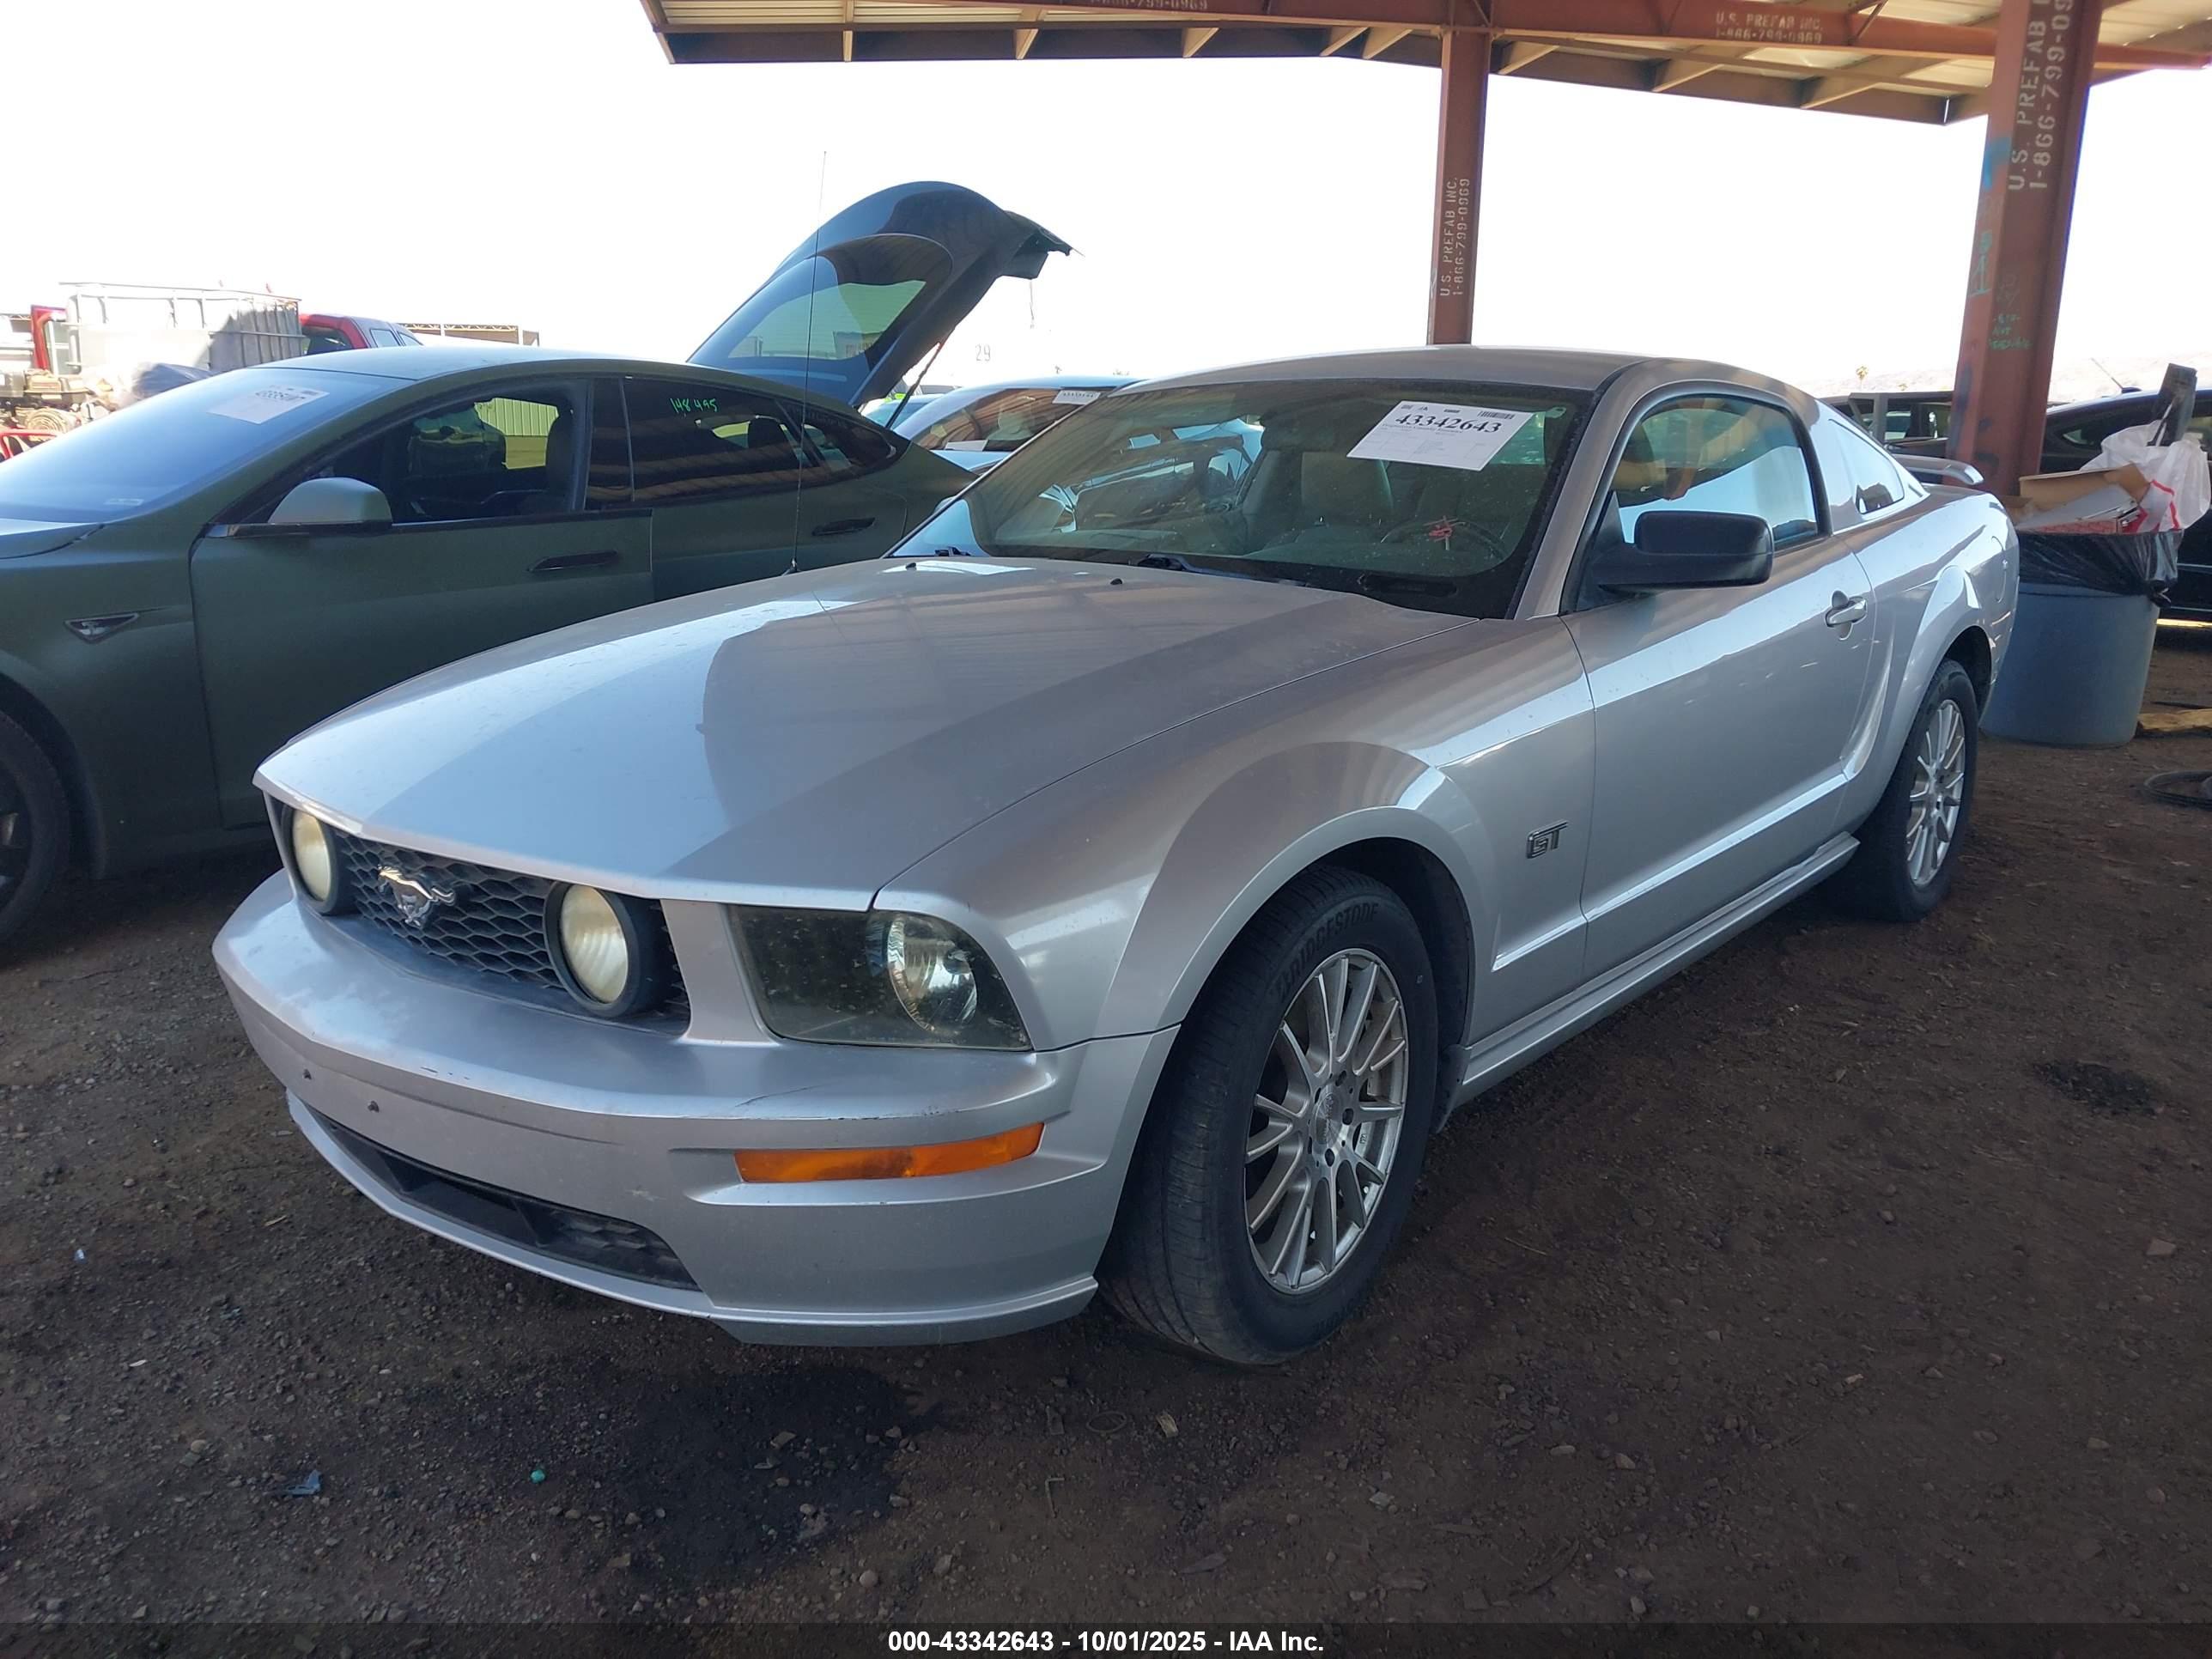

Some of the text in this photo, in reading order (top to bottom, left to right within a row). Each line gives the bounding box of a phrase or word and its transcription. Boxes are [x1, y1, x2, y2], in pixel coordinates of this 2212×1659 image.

[1716, 11, 1823, 31] U.S. PREFAB INC.
[1717, 27, 1822, 44] 1-866-799-0969
[2017, 20, 2046, 125] PREFAB
[2008, 141, 2030, 191] U.S.
[1440, 177, 1458, 296] U.S. PREFAB INC.
[1453, 179, 1470, 295] 1-866-799-0969
[975, 343, 991, 362] 29
[670, 398, 717, 413] 148 495
[1395, 413, 1502, 433] 43342643
[1526, 819, 1568, 859] GT
